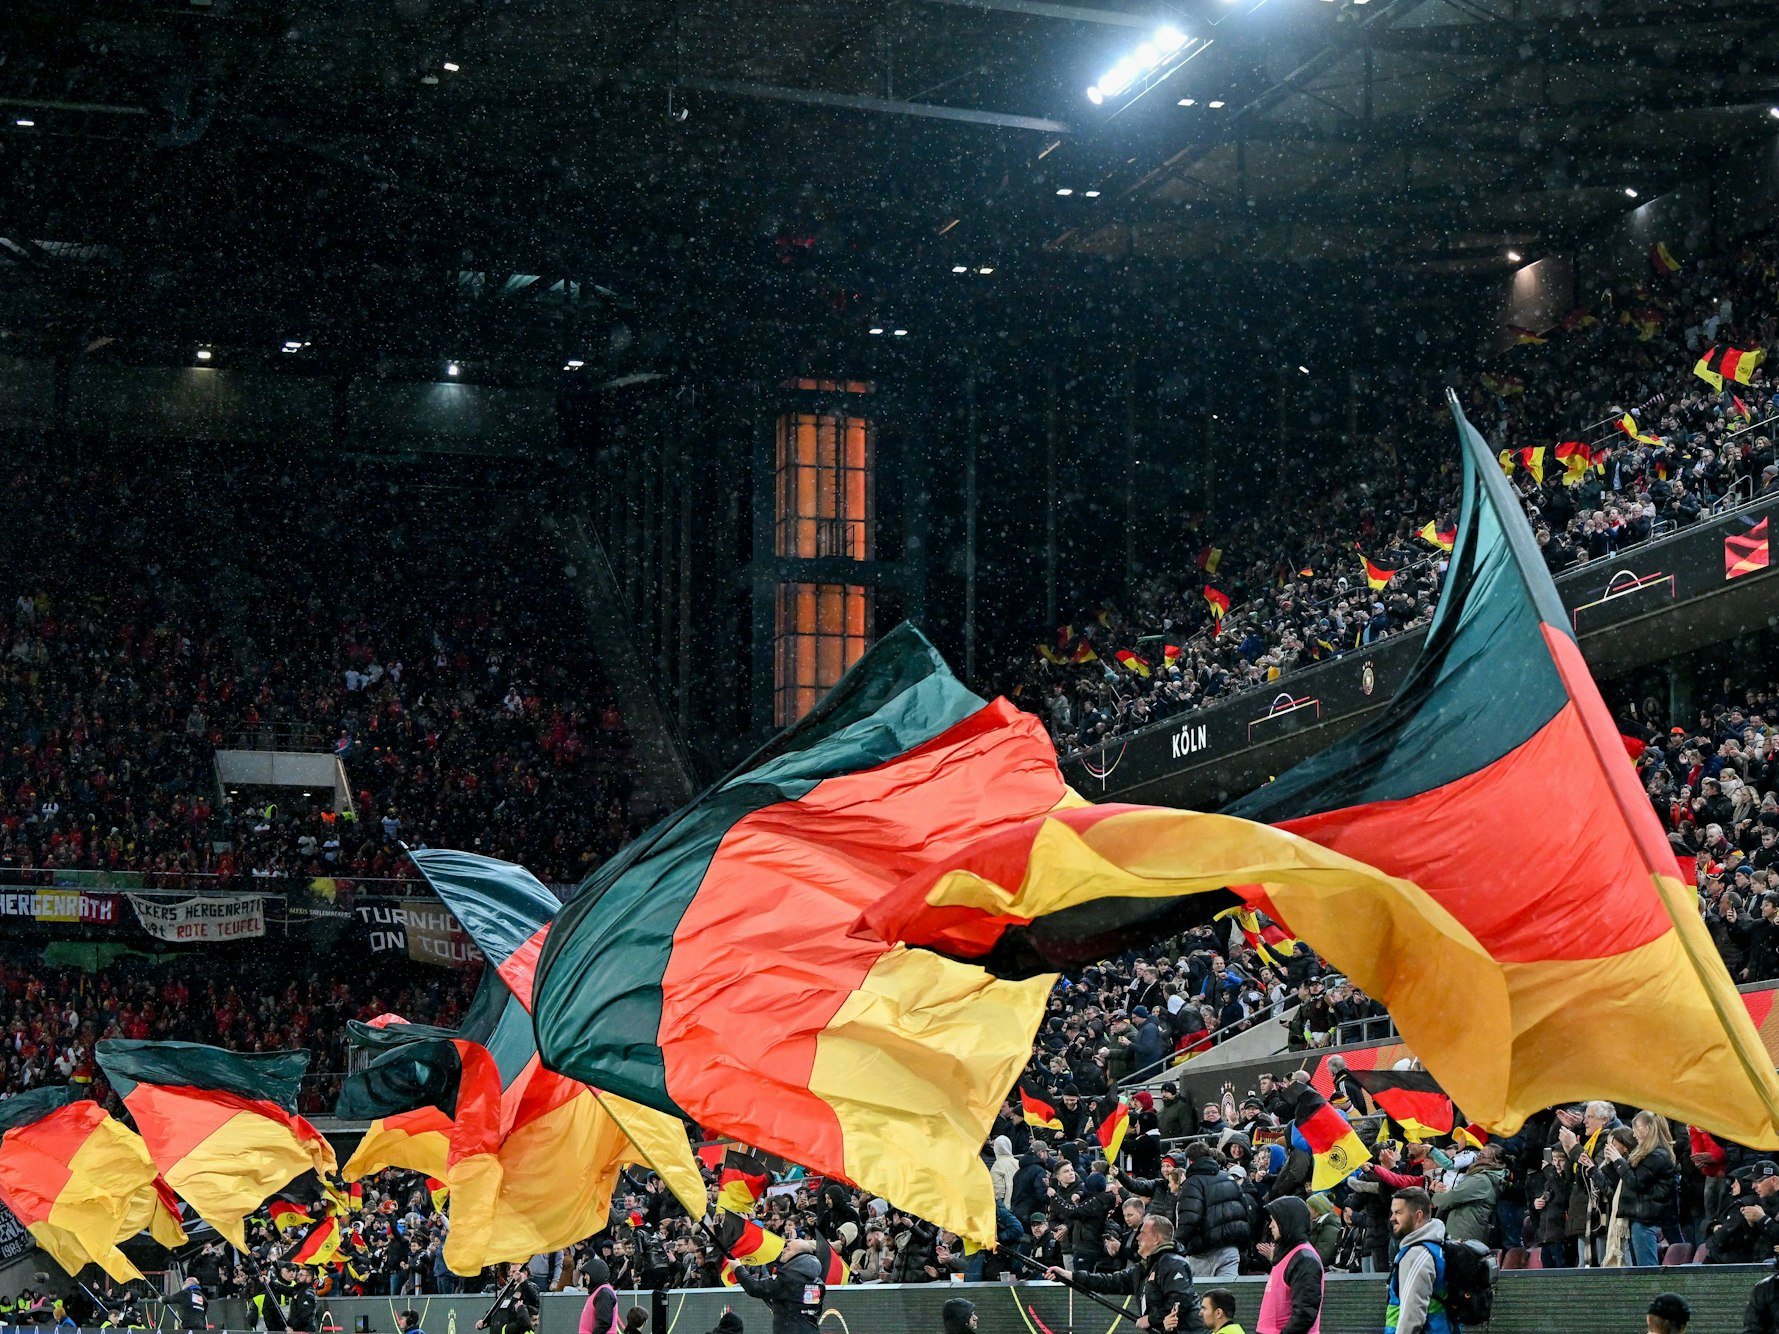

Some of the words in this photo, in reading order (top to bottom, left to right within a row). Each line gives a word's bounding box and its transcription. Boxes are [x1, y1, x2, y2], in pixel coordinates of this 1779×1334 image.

[1172, 724, 1207, 759] KÖLN
[217, 918, 261, 936] TEUFEL
[370, 931, 405, 953] ON
